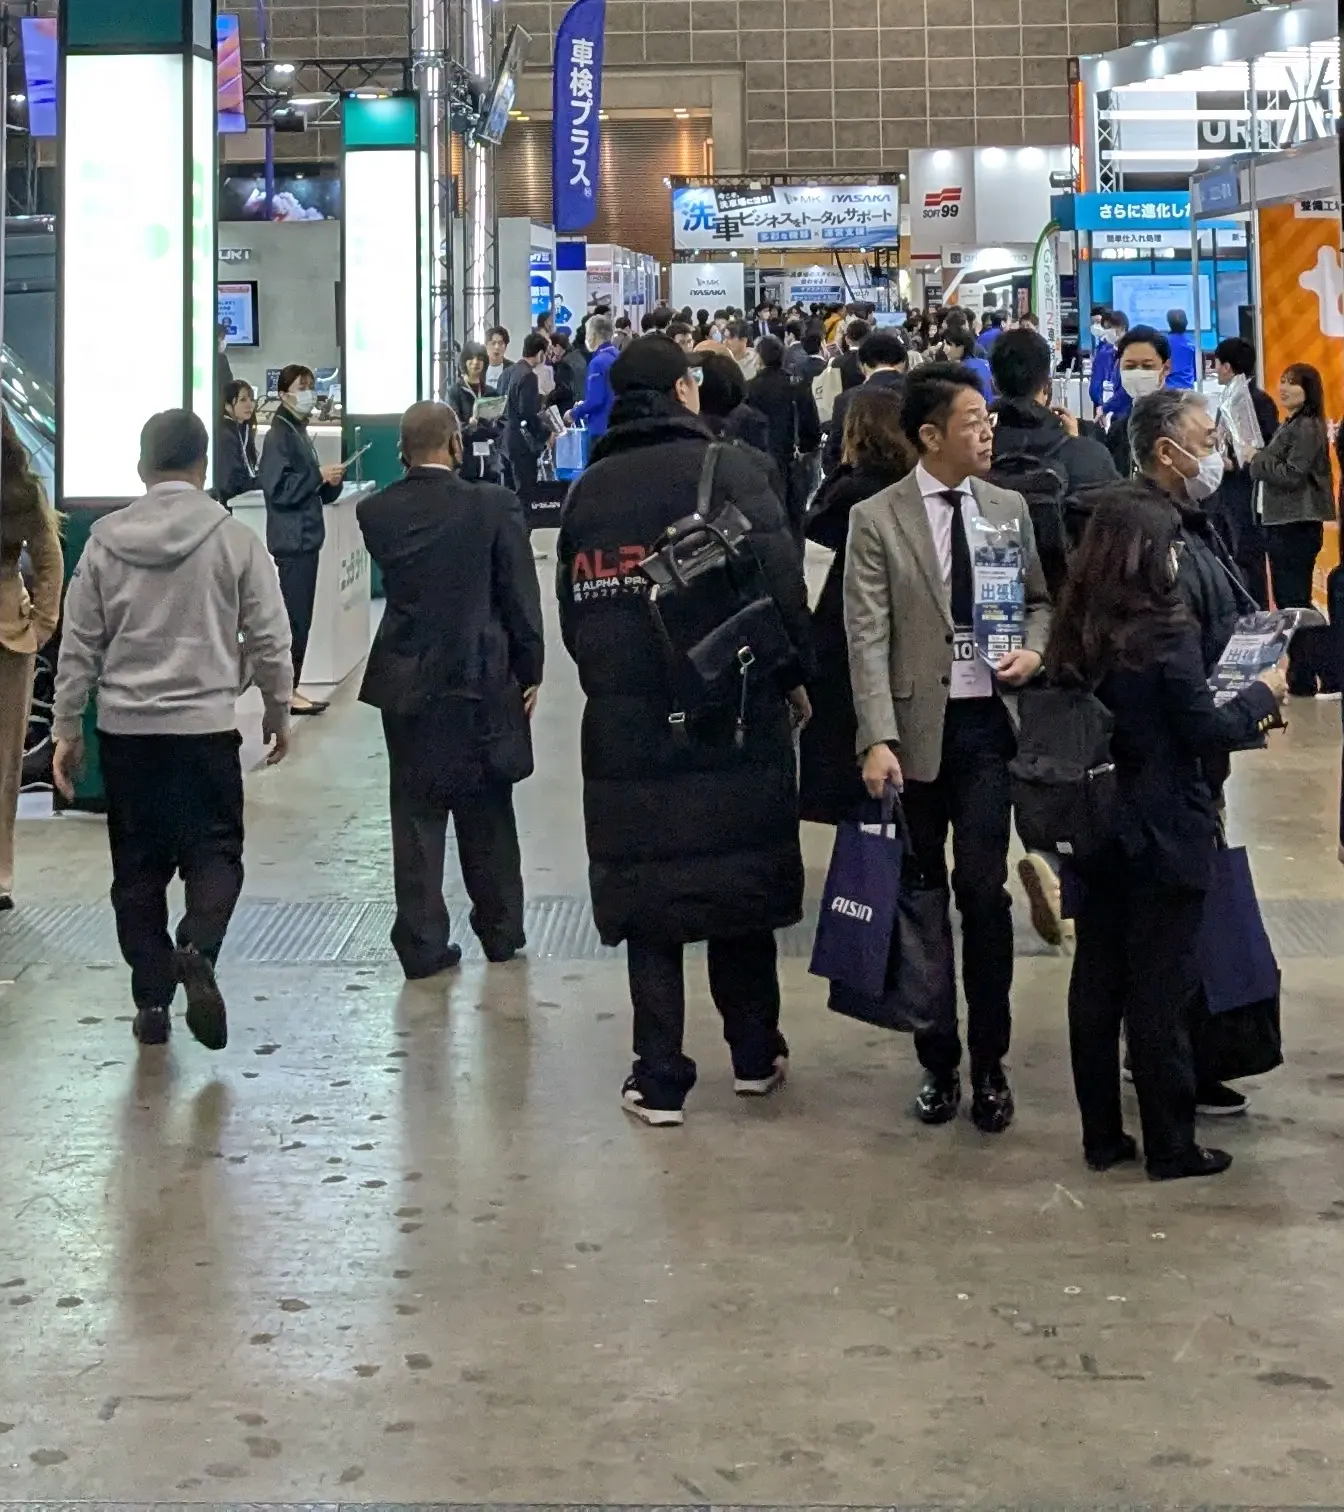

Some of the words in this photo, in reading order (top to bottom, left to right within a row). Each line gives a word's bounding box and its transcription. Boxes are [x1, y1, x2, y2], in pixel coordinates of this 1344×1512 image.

[569, 37, 595, 187] 車検プラス
[800, 195, 822, 204] MK
[922, 209, 941, 219] SOFT
[941, 203, 959, 218] 99
[572, 544, 647, 584] ALP
[582, 577, 620, 592] ALPHA
[831, 896, 873, 923] AISIN
